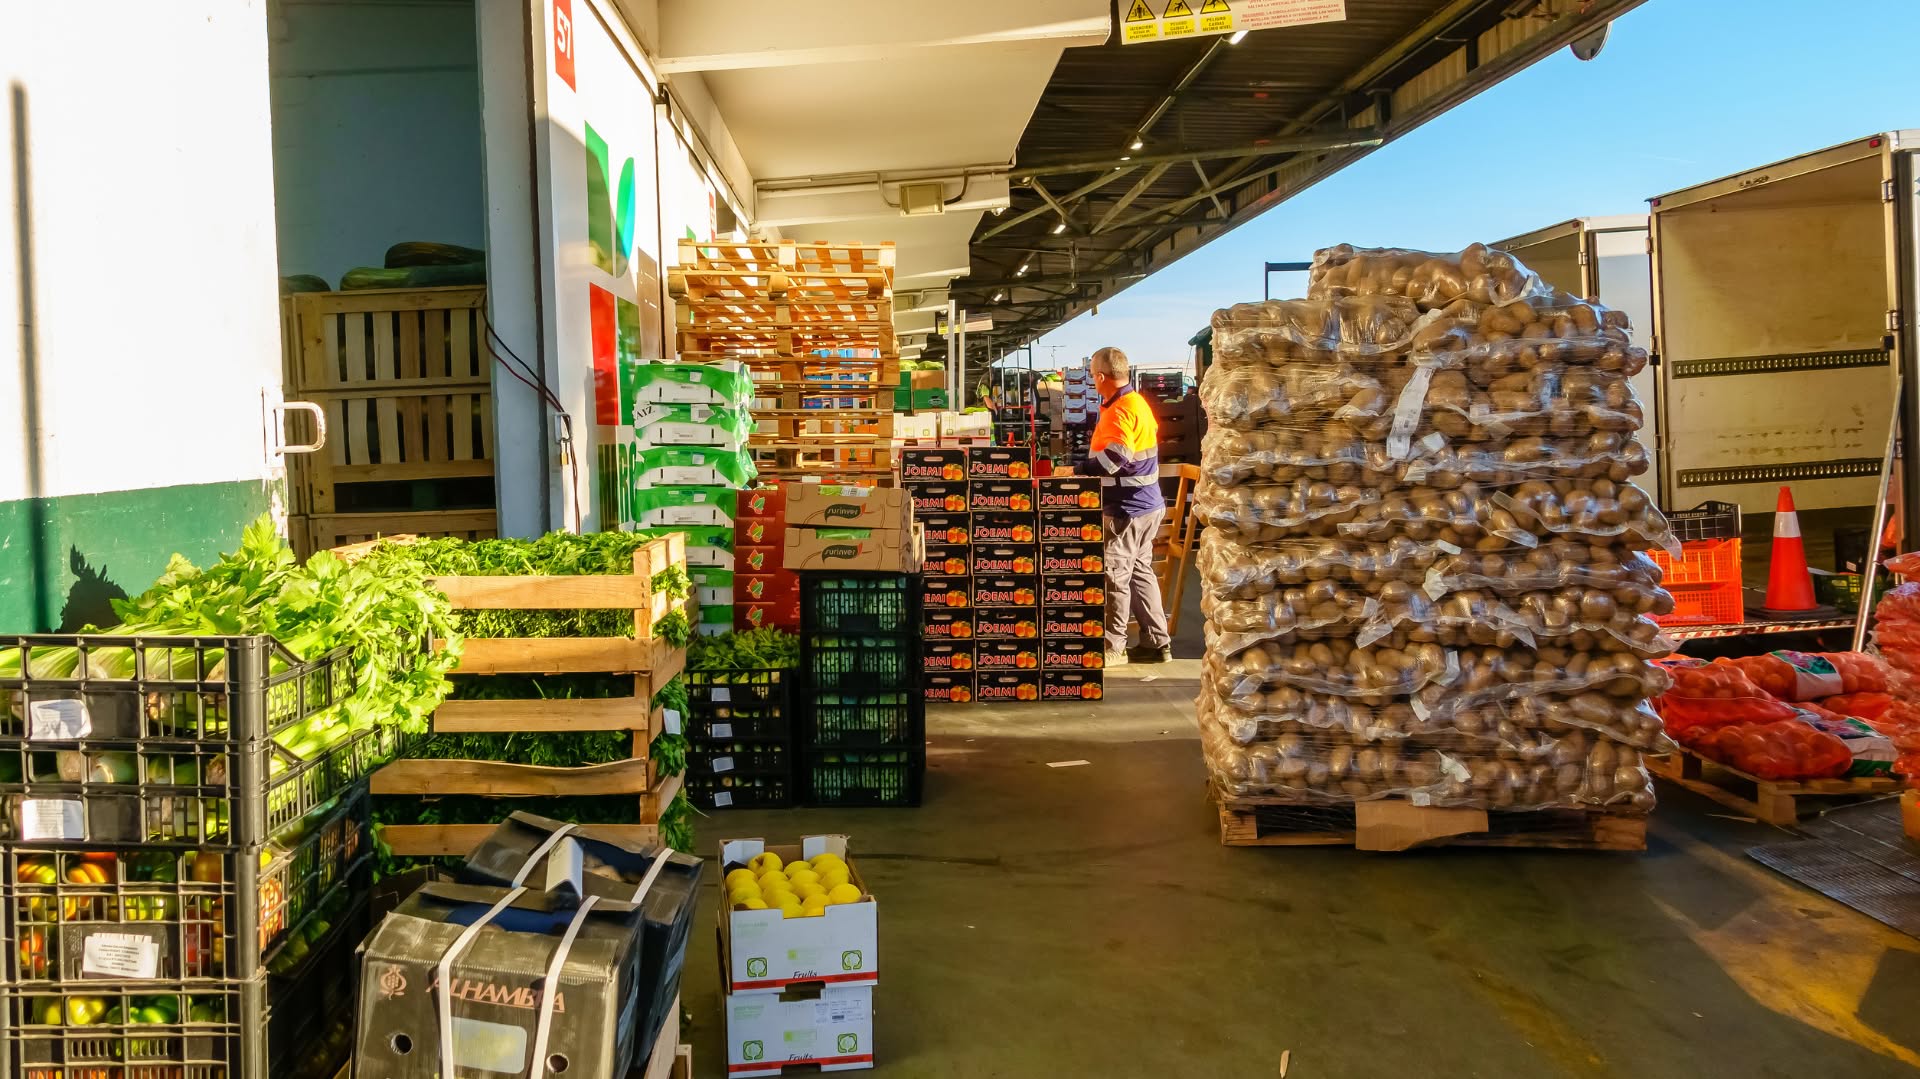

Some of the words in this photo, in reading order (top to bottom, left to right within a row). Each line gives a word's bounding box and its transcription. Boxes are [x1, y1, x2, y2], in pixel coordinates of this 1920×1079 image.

[904, 466, 941, 476] JOEMI
[970, 464, 1007, 474] JOEMI
[914, 498, 944, 508] OEMI
[972, 496, 1009, 506] JOEMI
[1040, 495, 1077, 506] JOEMI
[926, 530, 946, 540] EMI
[974, 528, 1011, 538] JOEMI
[1043, 527, 1080, 537] JOEMI
[923, 561, 944, 571] EMI
[974, 561, 1012, 570] JOEMI
[1044, 559, 1081, 569] JOEMI
[924, 593, 946, 603] EMI
[976, 592, 1014, 602] JOEMI
[1045, 591, 1082, 601] JOEMI
[925, 624, 950, 634] EMI
[977, 624, 1014, 634] JOEMI
[1045, 623, 1081, 633] JOEMI
[924, 656, 950, 666] EMI
[978, 655, 1015, 665] JOEMI
[1044, 654, 1081, 664] JOEMI
[924, 688, 950, 698] EMI
[978, 687, 1015, 697] JOEMI
[1043, 686, 1080, 696] JOEMI
[792, 970, 817, 979] Fruits
[788, 1053, 813, 1061] Fruits
